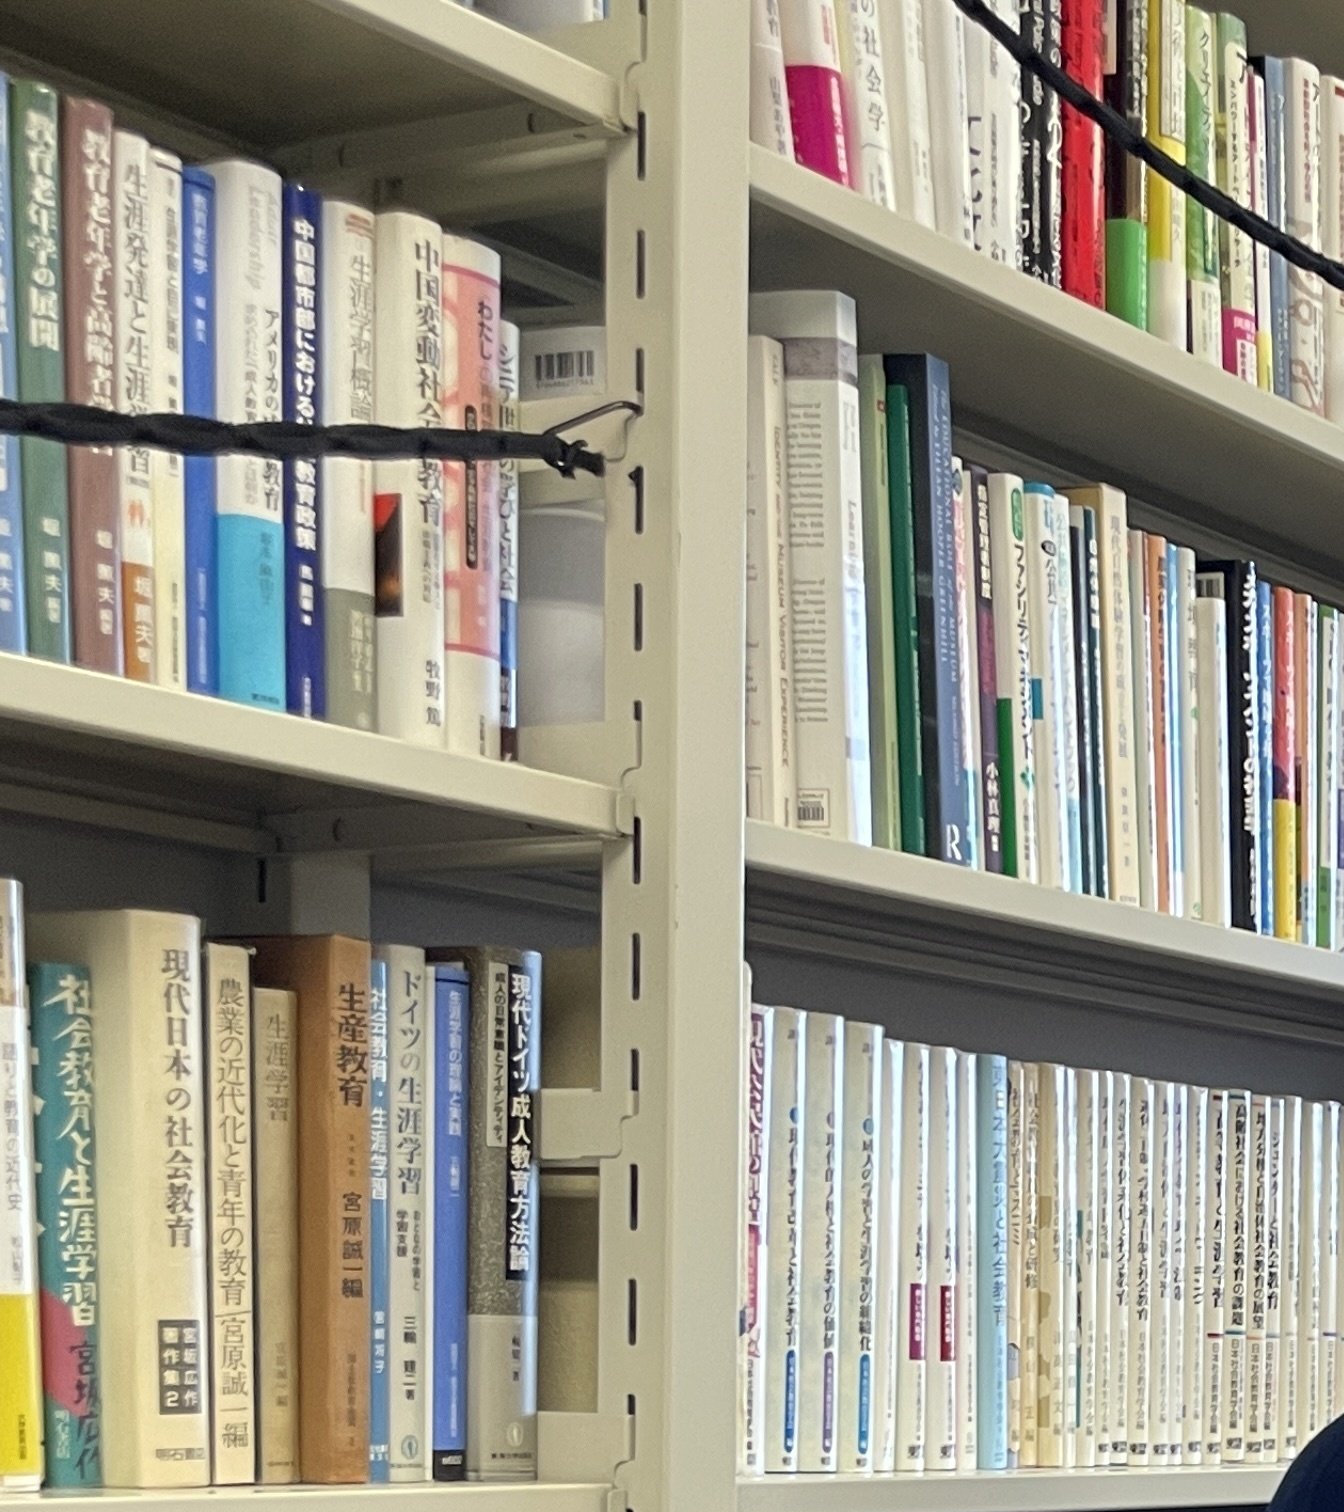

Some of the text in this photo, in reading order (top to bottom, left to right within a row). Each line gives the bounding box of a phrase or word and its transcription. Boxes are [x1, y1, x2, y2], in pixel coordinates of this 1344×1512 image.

[124, 163, 151, 474] 生涯発達と生涯習
[263, 309, 282, 512] アメリカの教育
[350, 255, 373, 422] 生涯学習概論
[414, 239, 441, 527] 中国変動社会教育
[777, 543, 785, 608] MUSEUM
[778, 611, 786, 671] VISITOR
[781, 677, 789, 767] EXPERIENCE
[161, 949, 196, 1248] 現代日本の社会教育
[265, 1013, 290, 1122] 生涯学習
[335, 983, 369, 1108] 生産教育
[371, 988, 389, 1201] 社会教育・生涯学習
[396, 970, 424, 1196] ドイツの生涯学習
[510, 972, 532, 1272] 現代ドイツ成人教育方法論
[40, 973, 97, 1327] 社会教育と生涯学習
[216, 978, 248, 1307] 農業の近代化と青年の教育
[162, 1325, 182, 1409] 著作集2
[182, 1325, 200, 1408] 宮坂広作
[220, 1316, 250, 1449] 宮原誠一編
